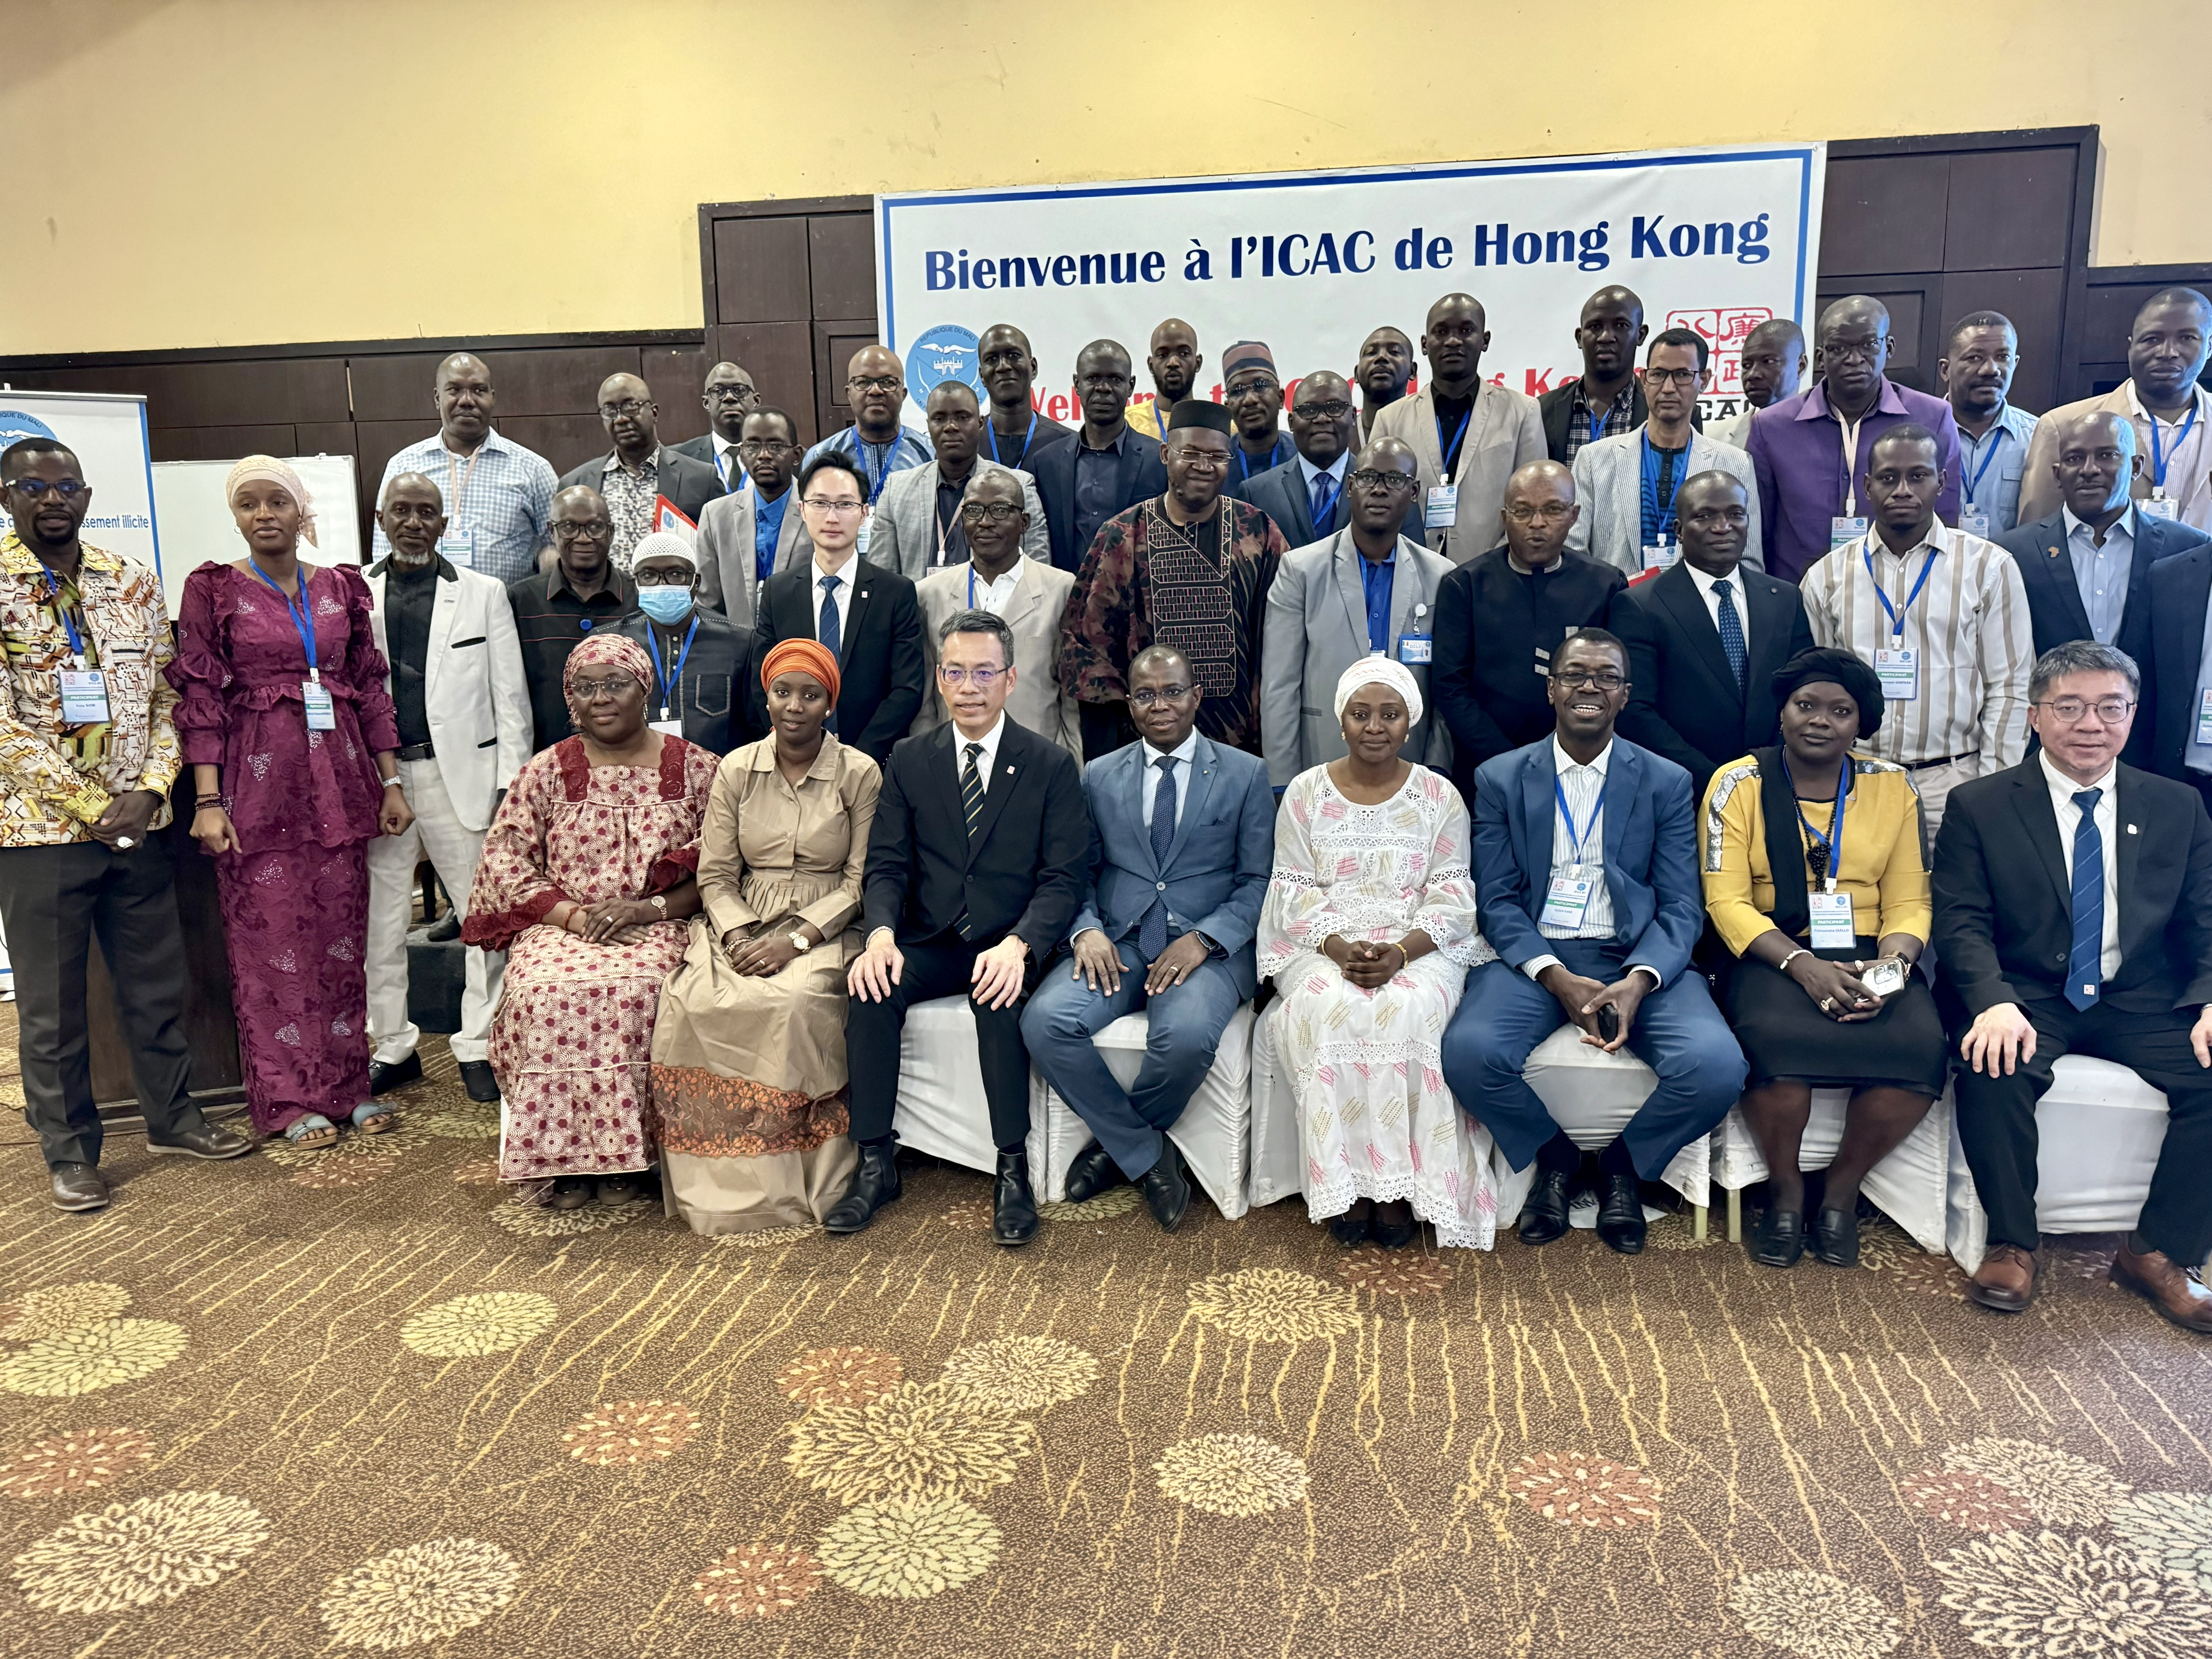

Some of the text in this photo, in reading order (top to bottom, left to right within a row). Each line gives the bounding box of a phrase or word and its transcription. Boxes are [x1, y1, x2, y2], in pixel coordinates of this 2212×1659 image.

[925, 249, 1165, 291] Bienvenue
[1184, 239, 1213, 281] à
[1394, 227, 1453, 271] de
[1475, 221, 1610, 271] Hong
[1631, 213, 1770, 264] Kong
[963, 331, 976, 341] MALI
[28, 417, 42, 428] MALI
[122, 515, 149, 528] illicite
